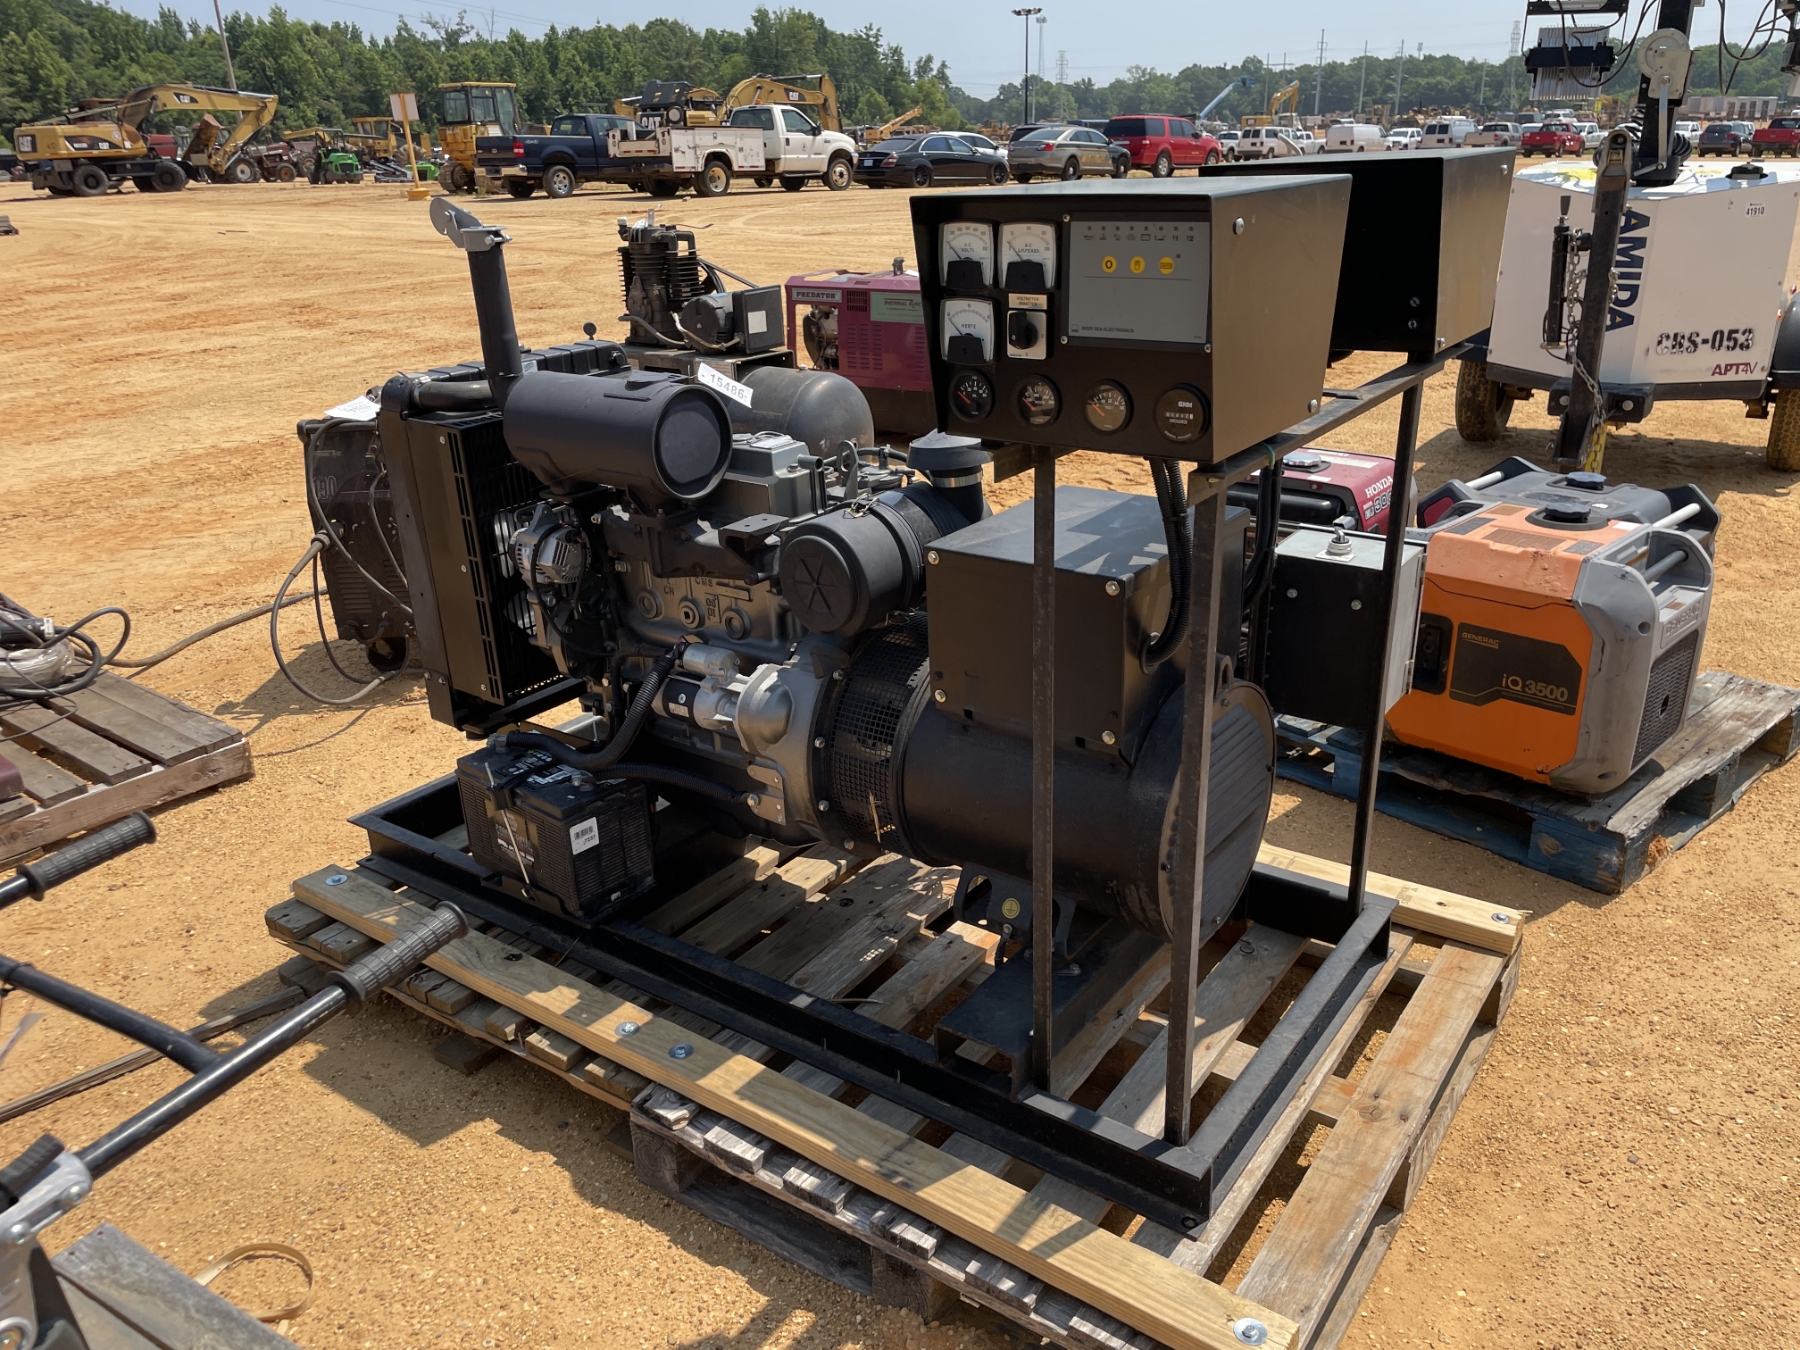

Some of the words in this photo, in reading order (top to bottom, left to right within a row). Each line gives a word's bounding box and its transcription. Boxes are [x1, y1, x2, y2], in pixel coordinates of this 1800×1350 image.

[641, 117, 661, 130] CAT
[1745, 206, 1765, 216] 41910
[1606, 209, 1651, 332] AMIDA
[796, 291, 836, 299] PREDATOR
[710, 373, 745, 399] 15486
[1364, 475, 1394, 498] HONDA
[1461, 632, 1499, 645] GENERAC
[1502, 673, 1522, 692] iQ
[1524, 679, 1568, 702] 3500
